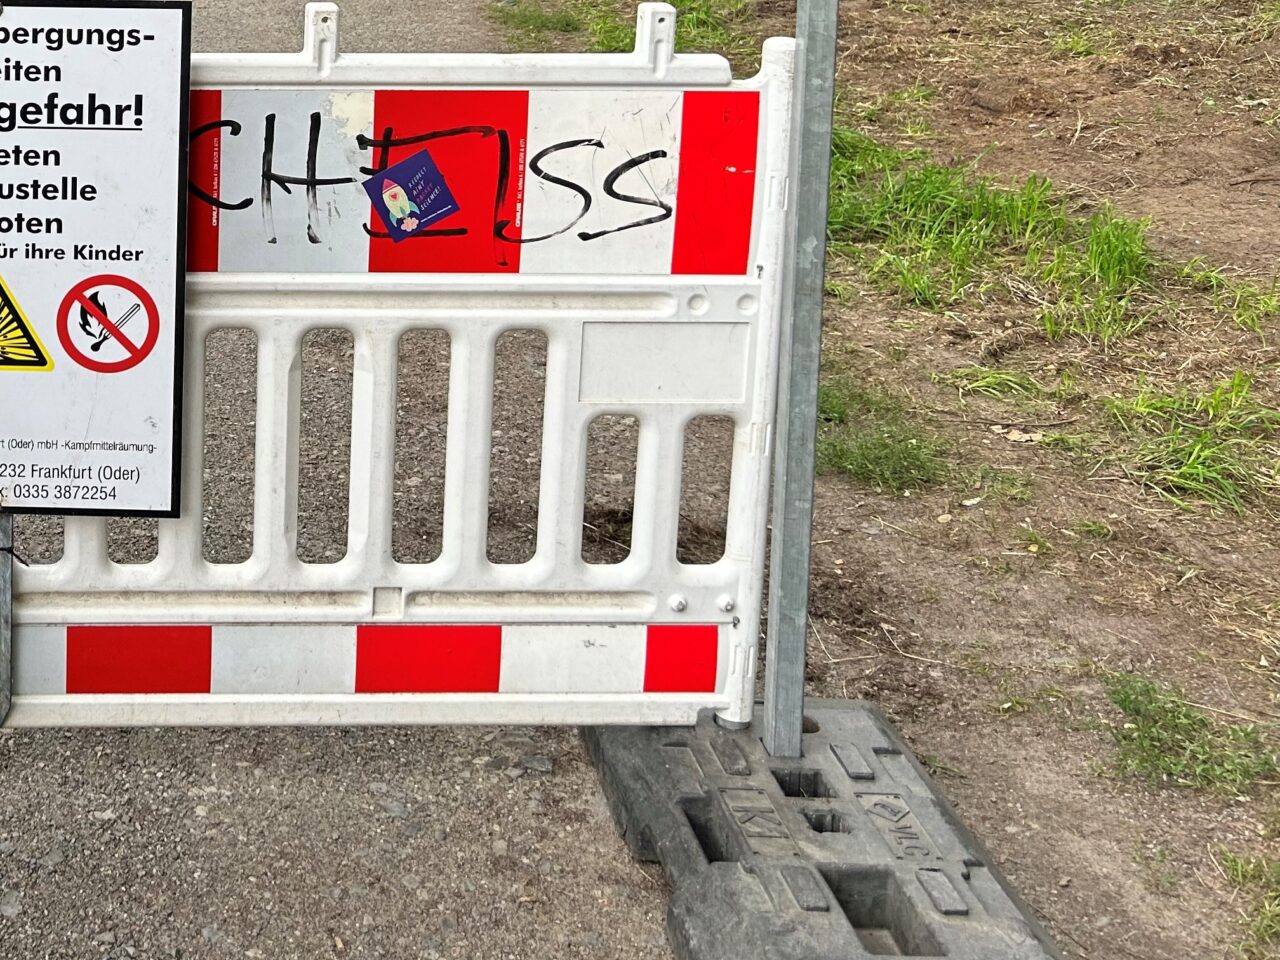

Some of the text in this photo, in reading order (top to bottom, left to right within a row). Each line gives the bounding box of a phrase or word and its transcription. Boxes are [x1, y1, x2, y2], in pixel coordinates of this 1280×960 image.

[25, 243, 65, 259] ihre
[74, 245, 143, 261] Kinder
[8, 439, 34, 451] (Oder)
[38, 440, 58, 449] mbH
[32, 464, 92, 479] Frankfurt
[98, 466, 140, 484] (Oder)
[14, 484, 48, 498] 0335
[54, 485, 116, 500] 3872254
